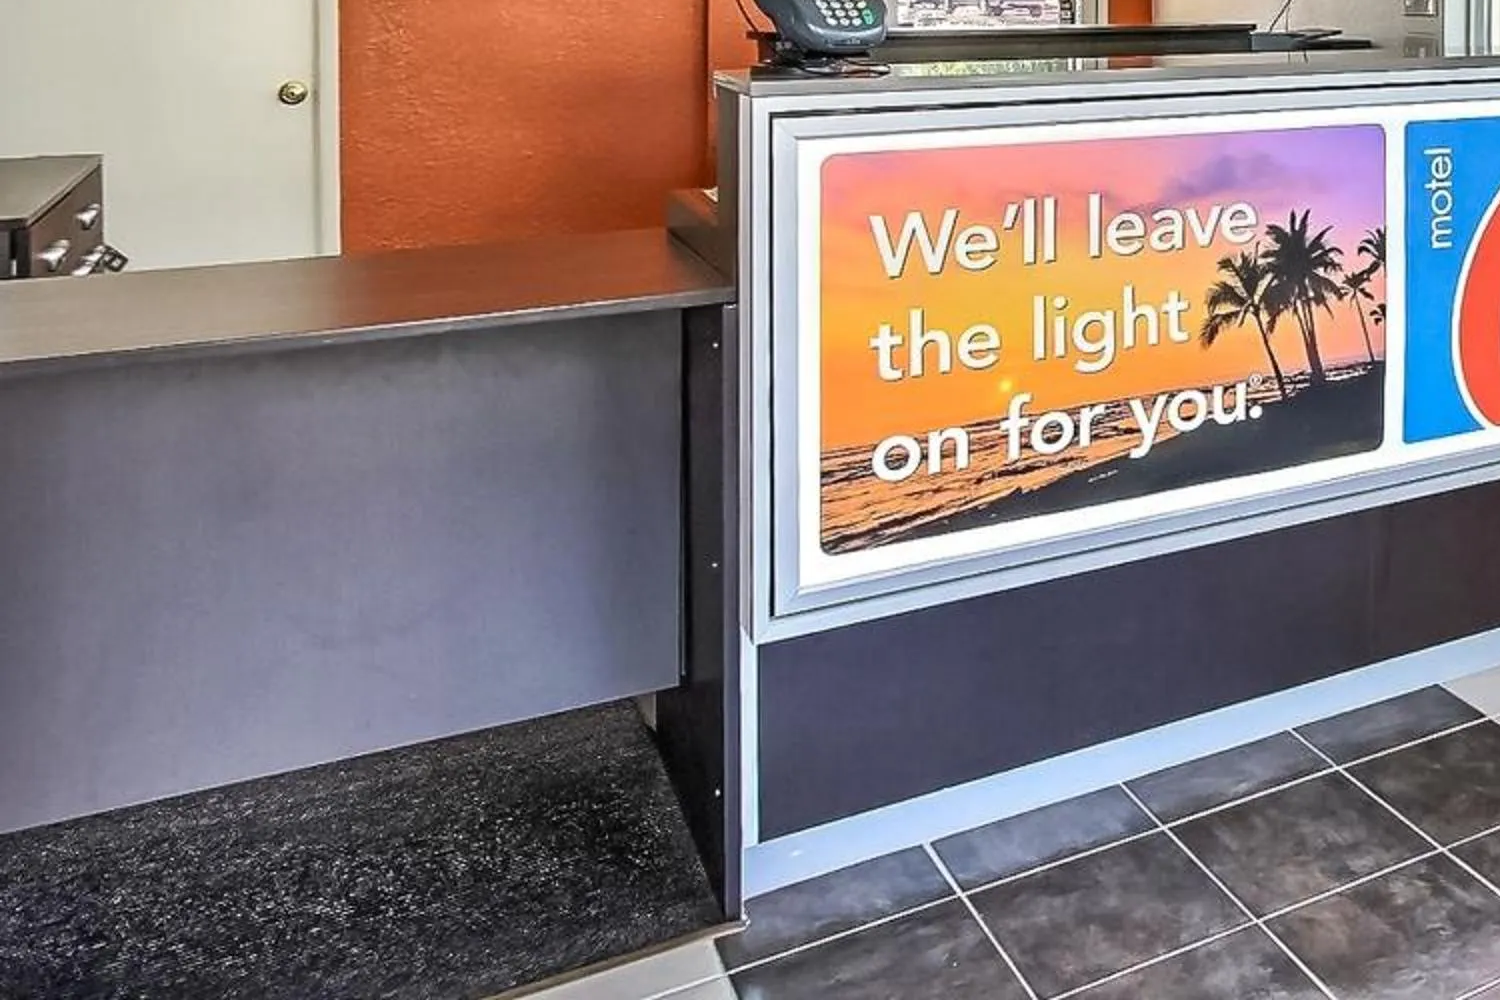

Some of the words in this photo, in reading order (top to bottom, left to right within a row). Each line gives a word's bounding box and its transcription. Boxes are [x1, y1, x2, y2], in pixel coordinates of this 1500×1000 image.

[870, 196, 1057, 278] We'll
[1088, 193, 1258, 257] leave
[1424, 148, 1452, 249] motel
[869, 308, 1001, 381] the
[1033, 284, 1190, 373] light
[872, 425, 971, 482] on
[1000, 392, 1105, 462] for
